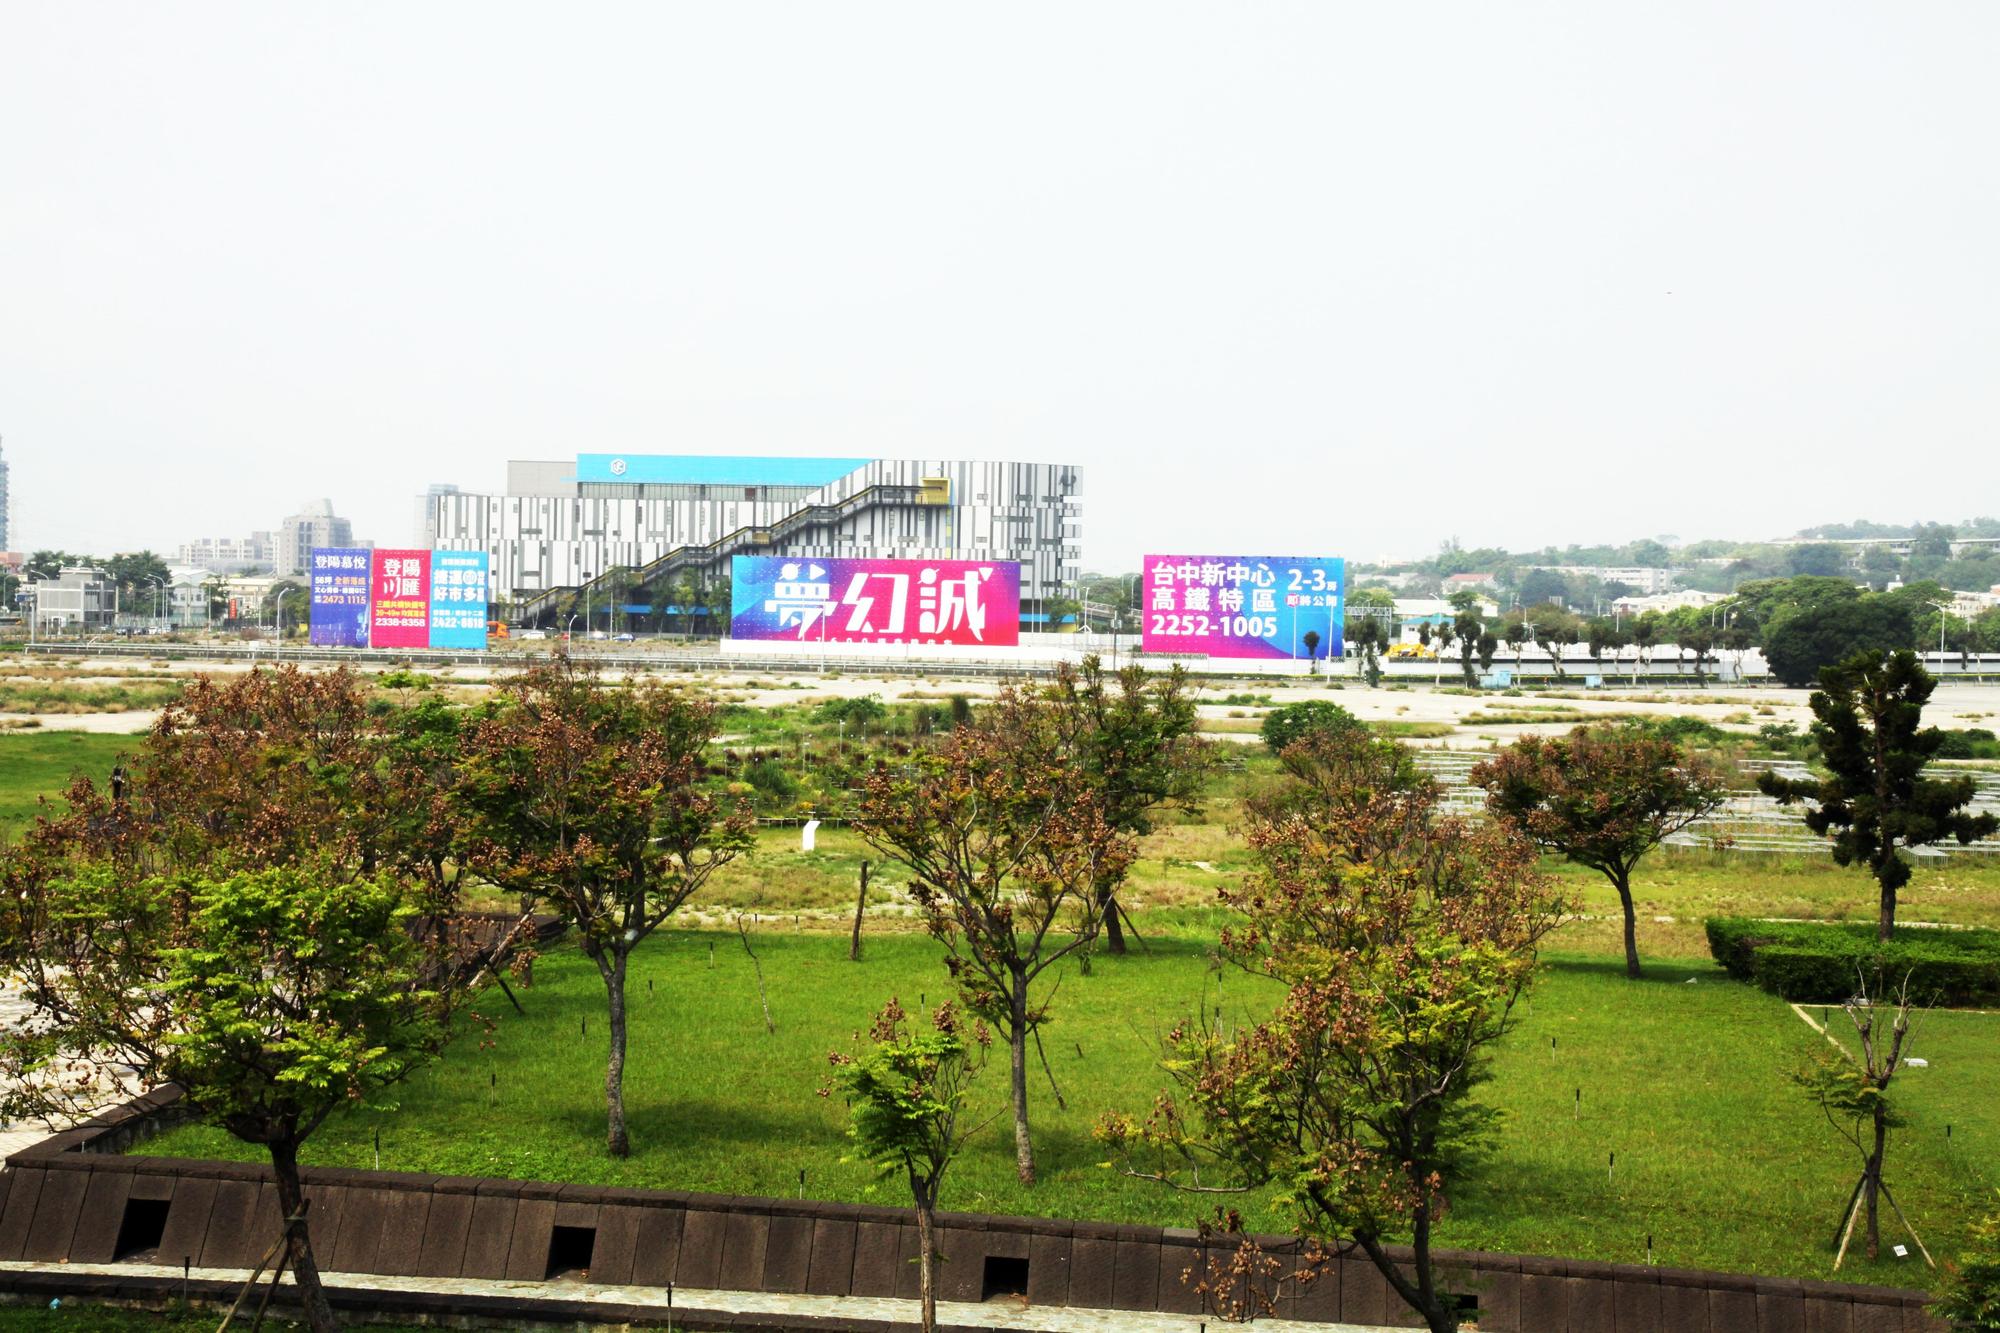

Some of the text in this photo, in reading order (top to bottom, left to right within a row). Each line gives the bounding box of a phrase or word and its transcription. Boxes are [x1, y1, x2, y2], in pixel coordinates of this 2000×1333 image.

[383, 559, 420, 577] 登陽
[1151, 562, 1276, 587] 台中新中心
[383, 577, 420, 599] 川匯
[1287, 569, 1337, 591] 2-3房
[347, 595, 367, 605] 1115
[433, 586, 477, 602] 好市多
[764, 563, 994, 642] 夢幻誠
[1151, 588, 1277, 612] 高鐵特區
[1286, 594, 1337, 607] 即將公開
[1151, 614, 1277, 637] 2252-1005
